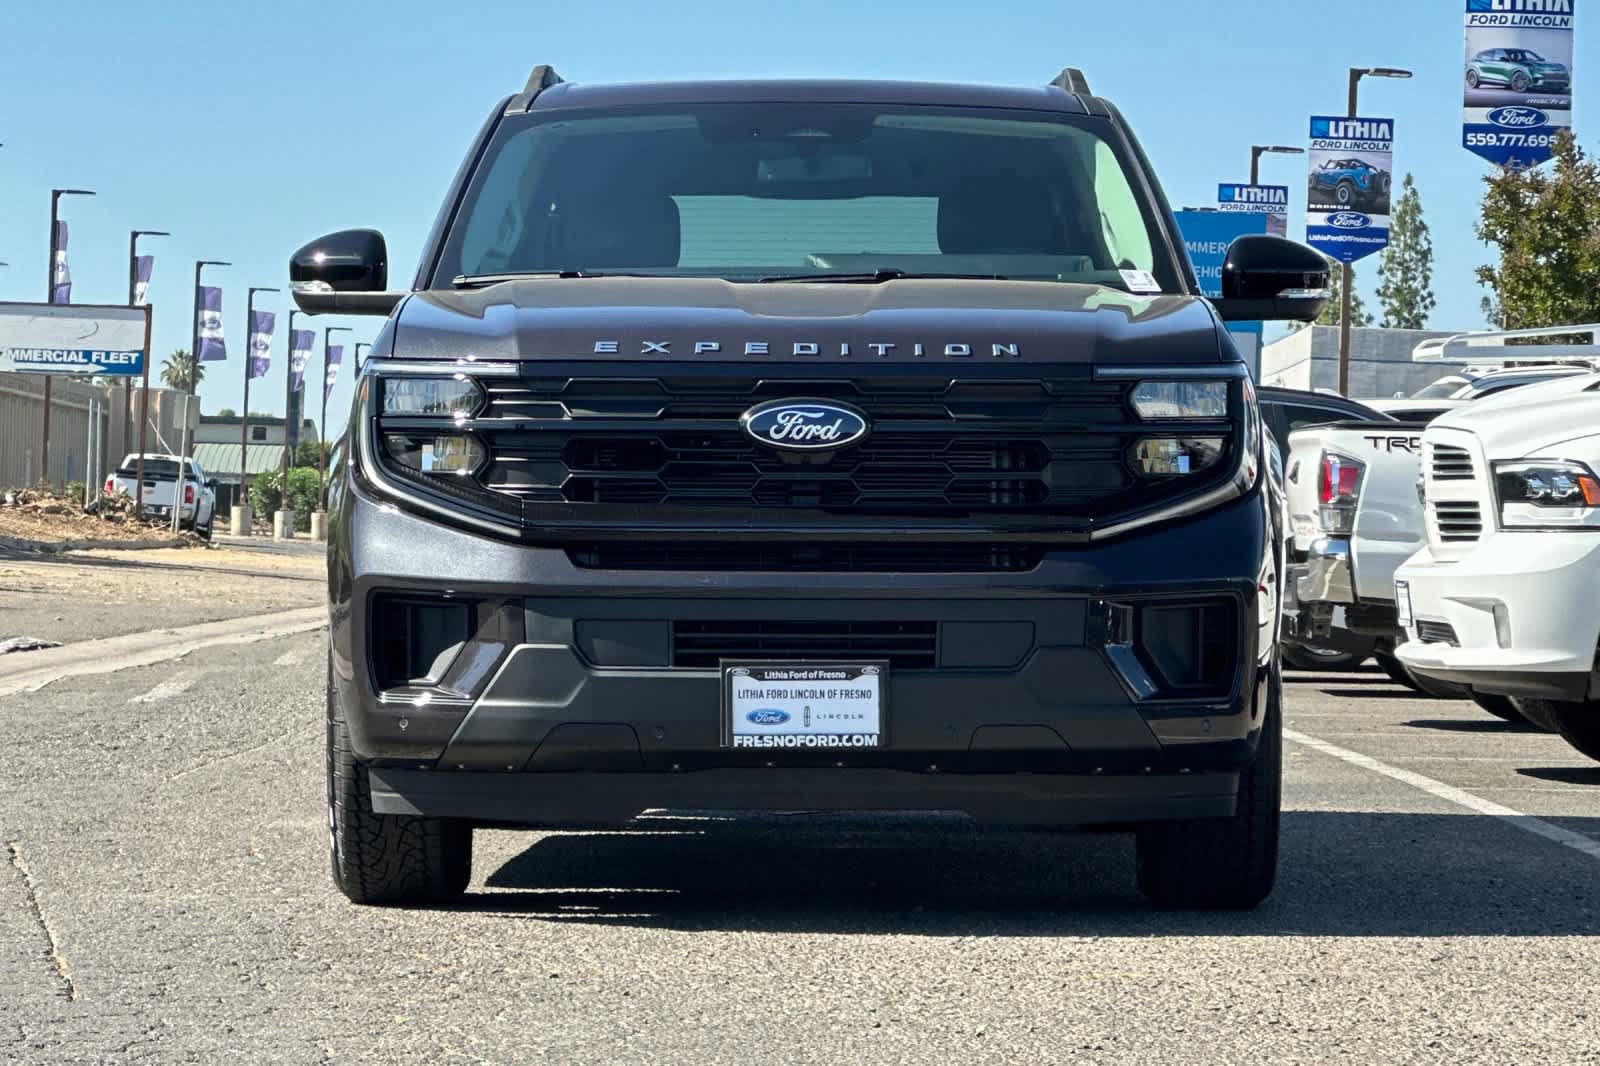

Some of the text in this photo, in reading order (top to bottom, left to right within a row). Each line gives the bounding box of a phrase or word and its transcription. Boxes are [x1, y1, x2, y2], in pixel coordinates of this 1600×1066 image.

[1470, 15, 1569, 26] FORD LINCOLN
[1498, 108, 1536, 125] Ford
[1329, 120, 1391, 139] LITHIA
[1312, 140, 1390, 150] FORD LINCOLN
[1466, 133, 1558, 147] 559.777.695
[1234, 187, 1286, 203] LITHIA
[1220, 203, 1286, 213] FORD LINCOLN
[1333, 213, 1363, 227] Ford
[594, 340, 1020, 357] EXPEDITION
[91, 351, 139, 364] FLEET
[770, 410, 842, 441] Ford
[764, 670, 846, 679] Lithia Ford of Fresno
[738, 689, 872, 700] LITHIA FORD LINCOLN OF FRESNO
[755, 711, 782, 723] Ford
[734, 735, 878, 747] FRESNOFORD.COM
